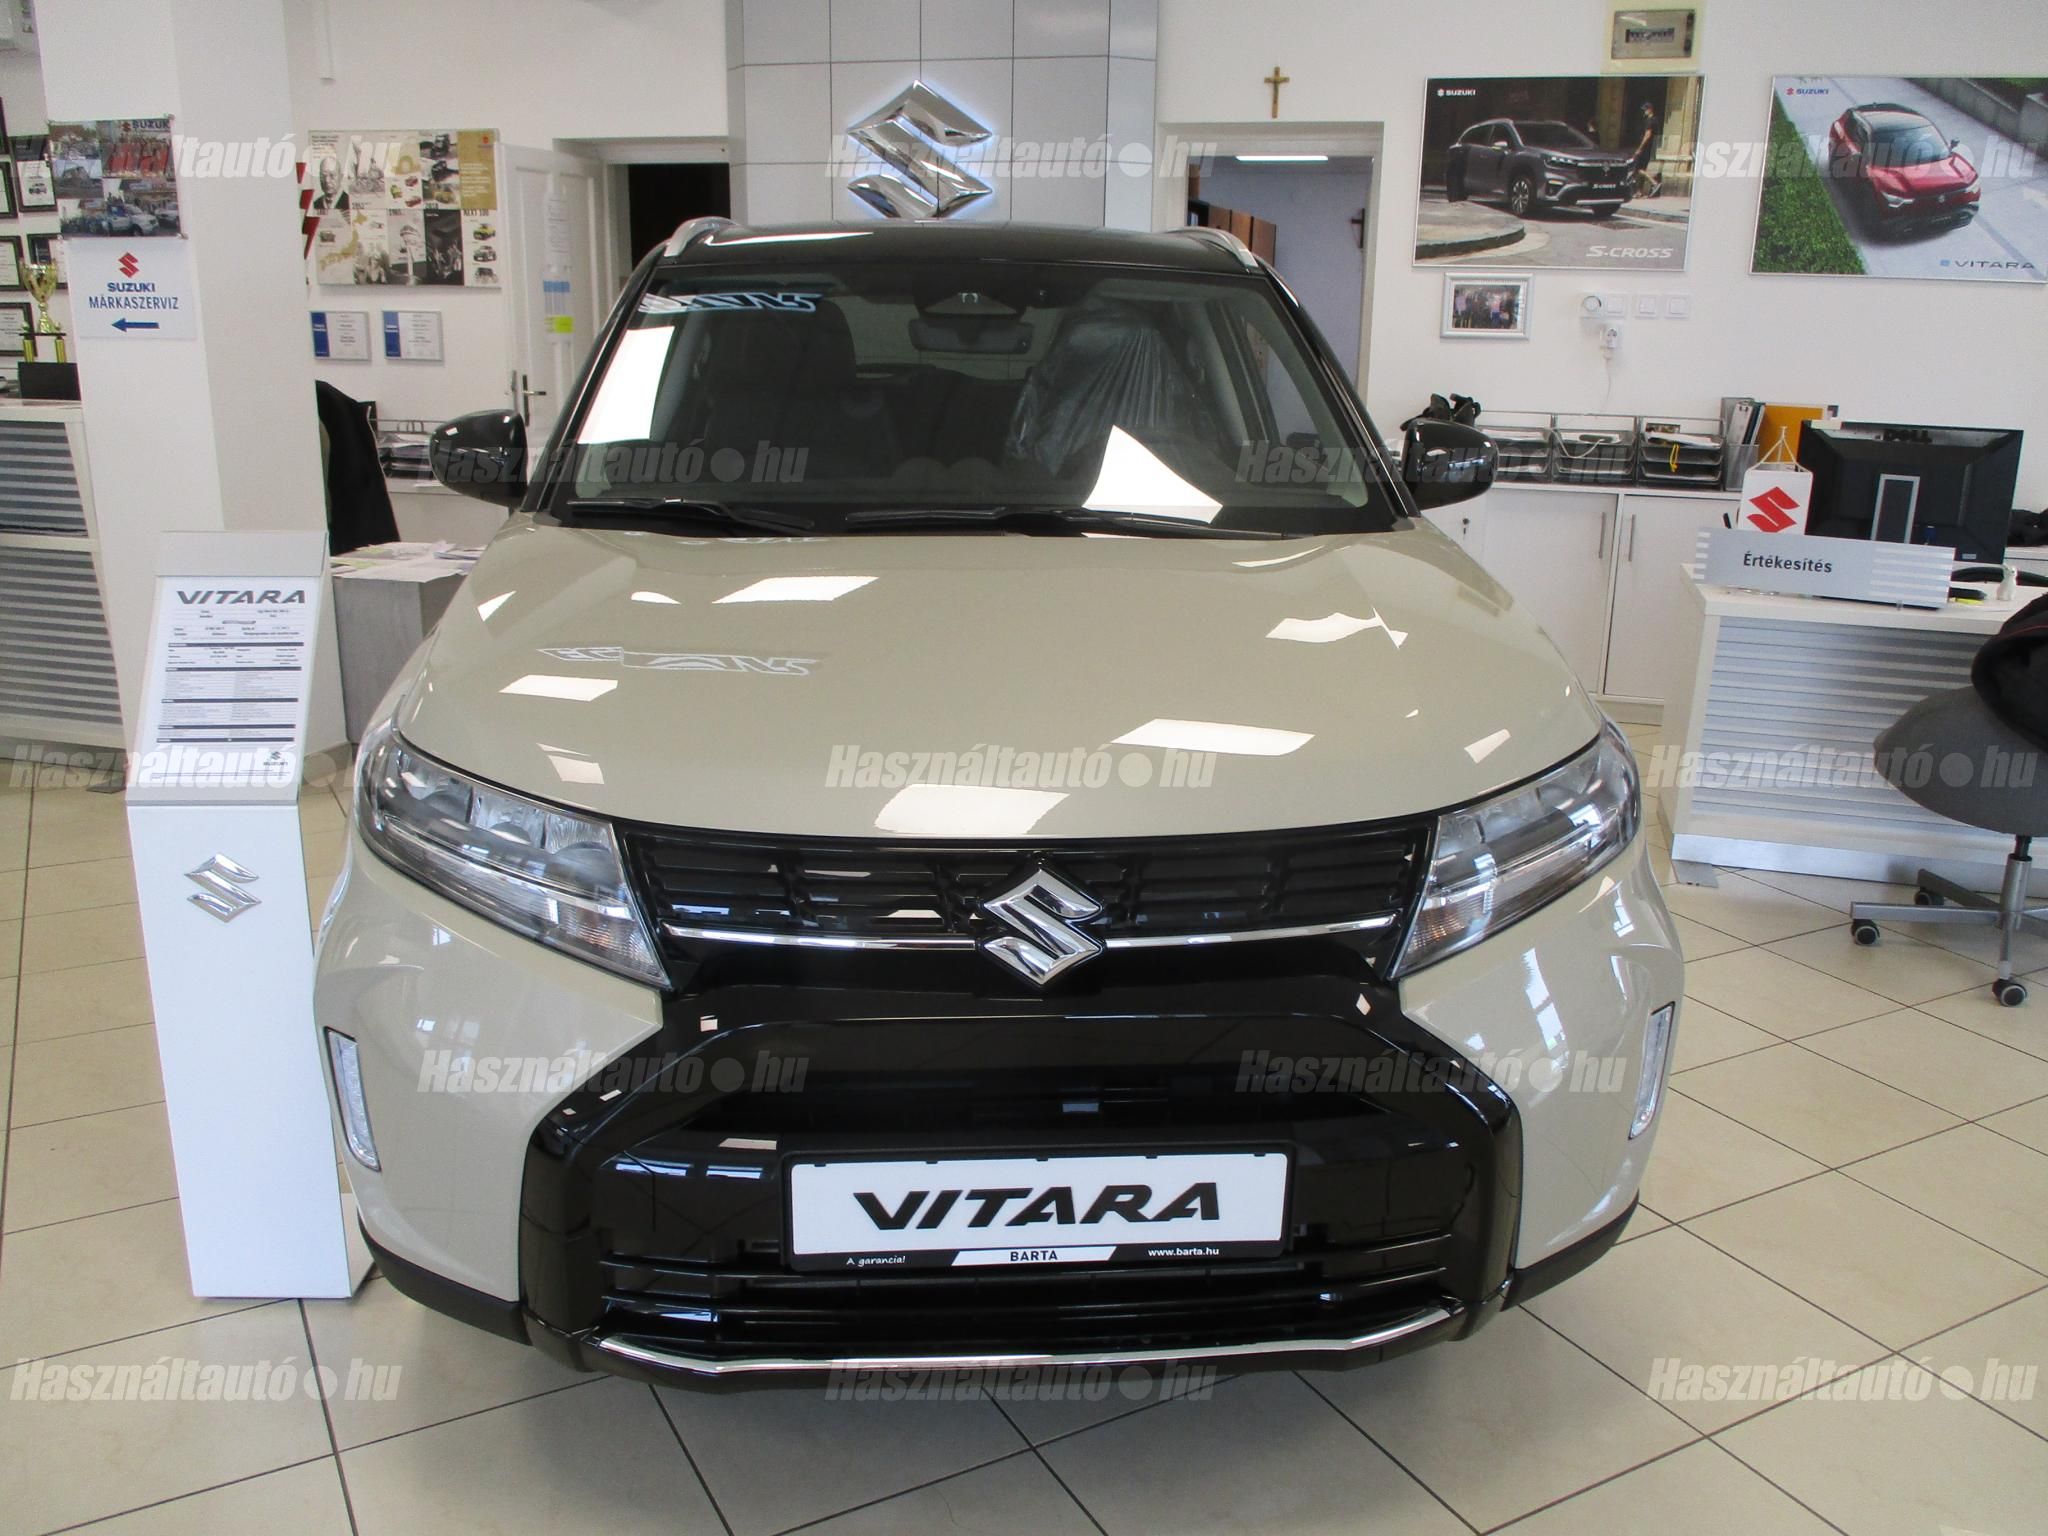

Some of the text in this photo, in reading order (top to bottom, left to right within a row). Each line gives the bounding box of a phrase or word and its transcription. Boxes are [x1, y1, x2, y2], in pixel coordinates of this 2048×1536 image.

[1955, 260, 2035, 269] VITARA
[107, 282, 156, 293] SUZUKI
[88, 294, 179, 310] MÁRKASZERVIZ
[1743, 551, 1832, 573] Értékesítés
[176, 590, 305, 604] VITARA
[852, 1182, 1220, 1230] VITARA
[1010, 1249, 1058, 1262] BARTA
[1148, 1247, 1219, 1257] www.barta.hu
[846, 1255, 906, 1268] A garancia!
